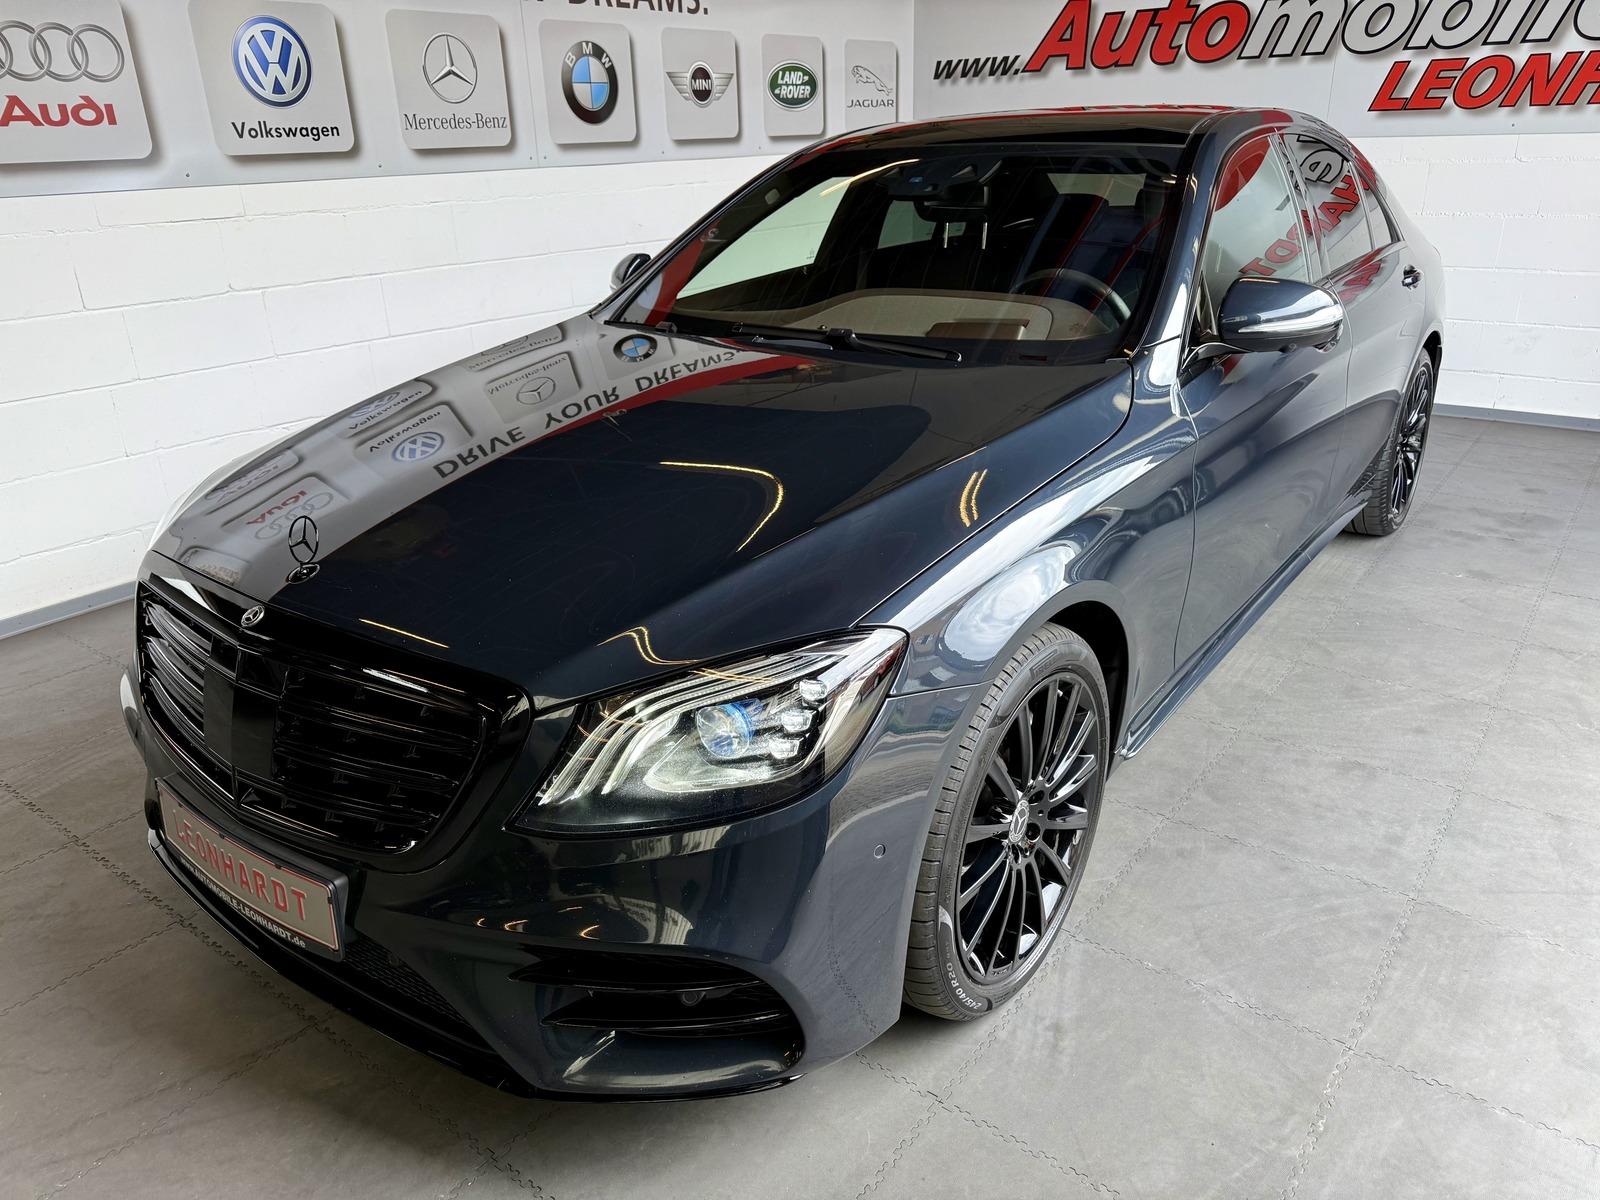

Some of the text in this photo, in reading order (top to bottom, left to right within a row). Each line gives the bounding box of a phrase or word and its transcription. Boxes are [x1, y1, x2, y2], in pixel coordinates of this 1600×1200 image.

[565, 41, 612, 69] BMW
[691, 78, 712, 91] MINI
[777, 70, 804, 84] LAND
[779, 85, 811, 99] ROVER
[0, 95, 118, 127] Audi
[846, 98, 894, 108] JAGUAR
[231, 120, 340, 142] Volkswagen
[403, 113, 508, 132] Mercedes-Benz
[173, 809, 307, 921] LEONHARDT
[955, 987, 982, 1010] 245/40
